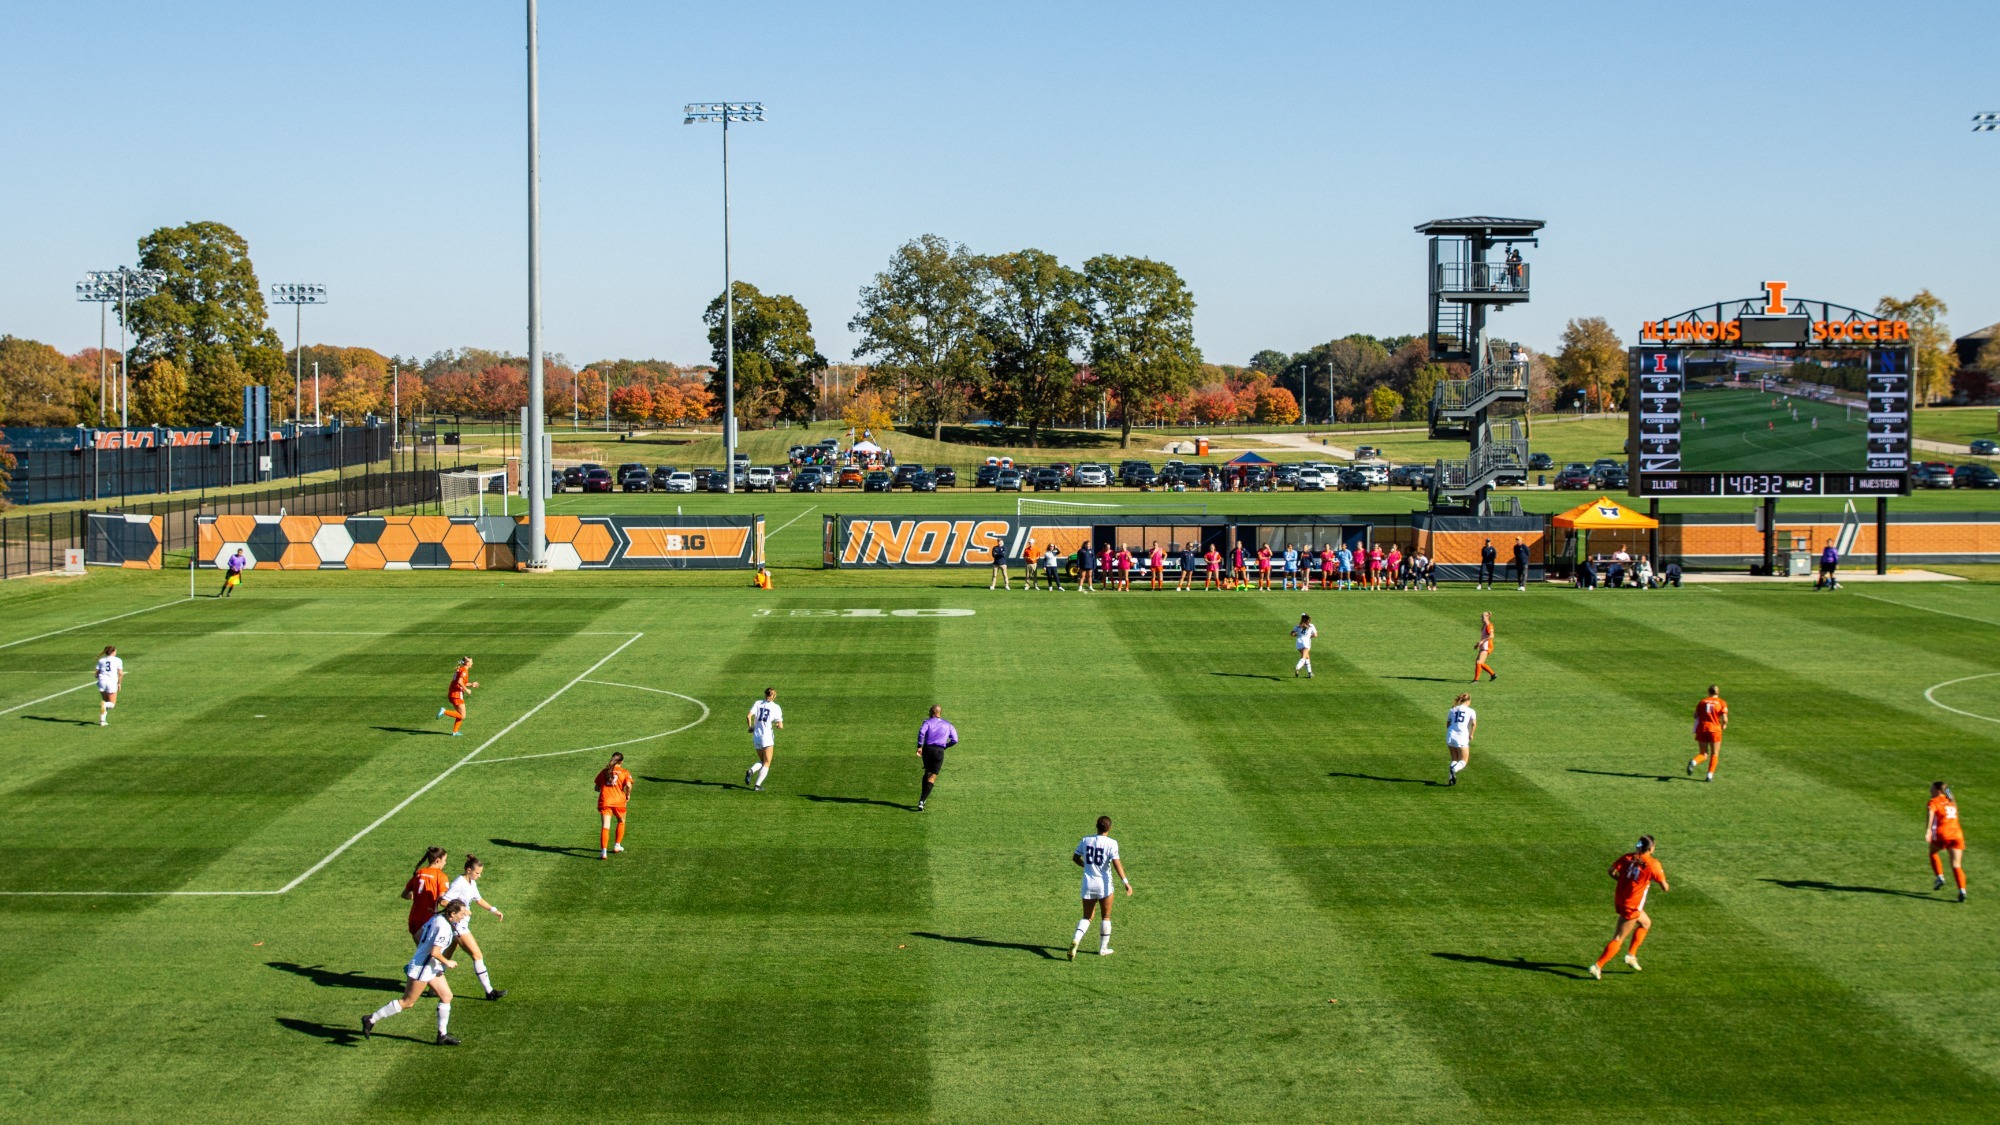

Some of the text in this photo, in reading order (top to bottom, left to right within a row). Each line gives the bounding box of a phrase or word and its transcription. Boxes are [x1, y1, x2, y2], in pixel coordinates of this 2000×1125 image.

[1764, 281, 1788, 315] I
[1643, 321, 1909, 340] ILLINOIS SOCCER
[1657, 382, 1664, 391] 6
[1883, 383, 1891, 392] 7
[1656, 404, 1664, 413] 2
[1883, 404, 1891, 412] 5
[1658, 424, 1664, 433] 1
[1884, 424, 1891, 433] 2
[1656, 444, 1664, 454] 4
[1884, 444, 1890, 453] 1
[1871, 459, 1904, 468] 2:15 PM
[1652, 477, 1715, 492] ILLINI 1
[1729, 475, 1783, 493] 40:32
[1786, 477, 1813, 491] HALF 2
[1848, 476, 1854, 492] 1
[105, 661, 111, 672] 3
[758, 707, 770, 722] 13
[1454, 711, 1466, 723] 15
[1085, 845, 1104, 866] 26
